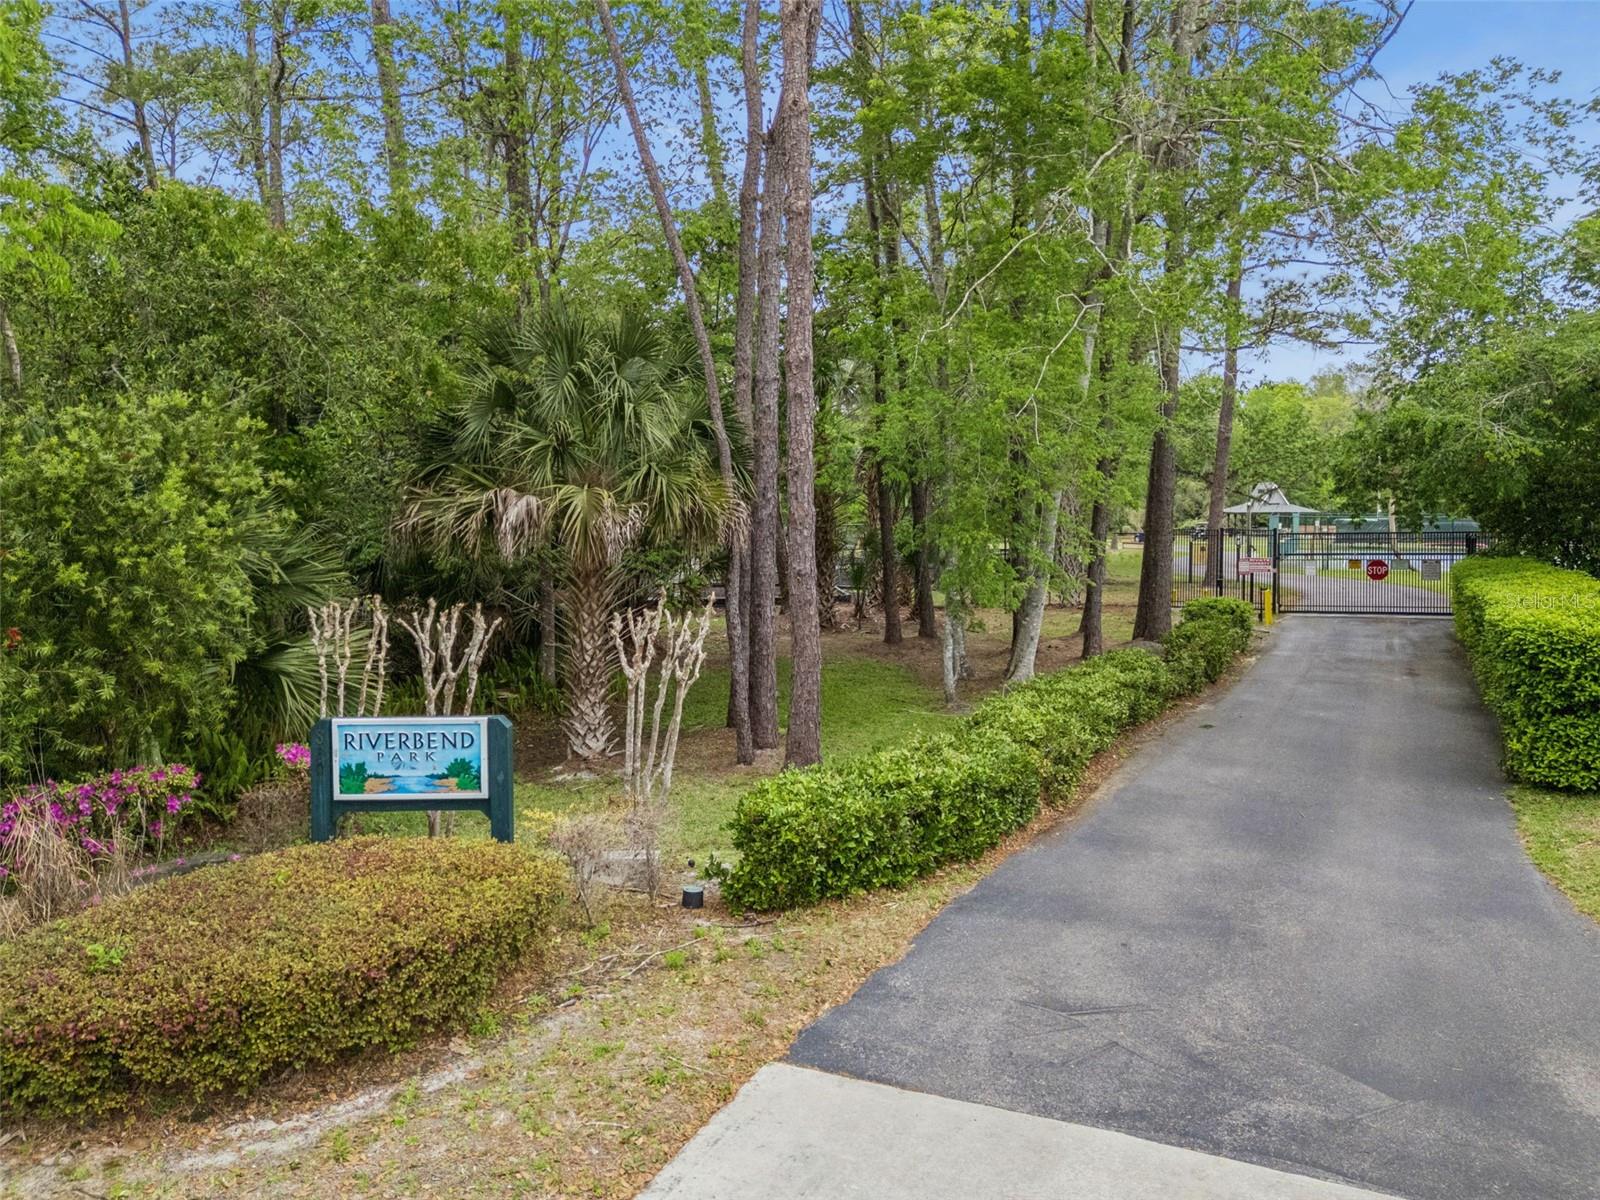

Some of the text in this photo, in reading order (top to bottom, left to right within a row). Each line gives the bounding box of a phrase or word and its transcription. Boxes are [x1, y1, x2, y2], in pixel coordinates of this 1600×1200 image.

[1367, 566, 1388, 575] STOP
[343, 731, 475, 751] RIVERBEND
[377, 751, 436, 762] PARK
